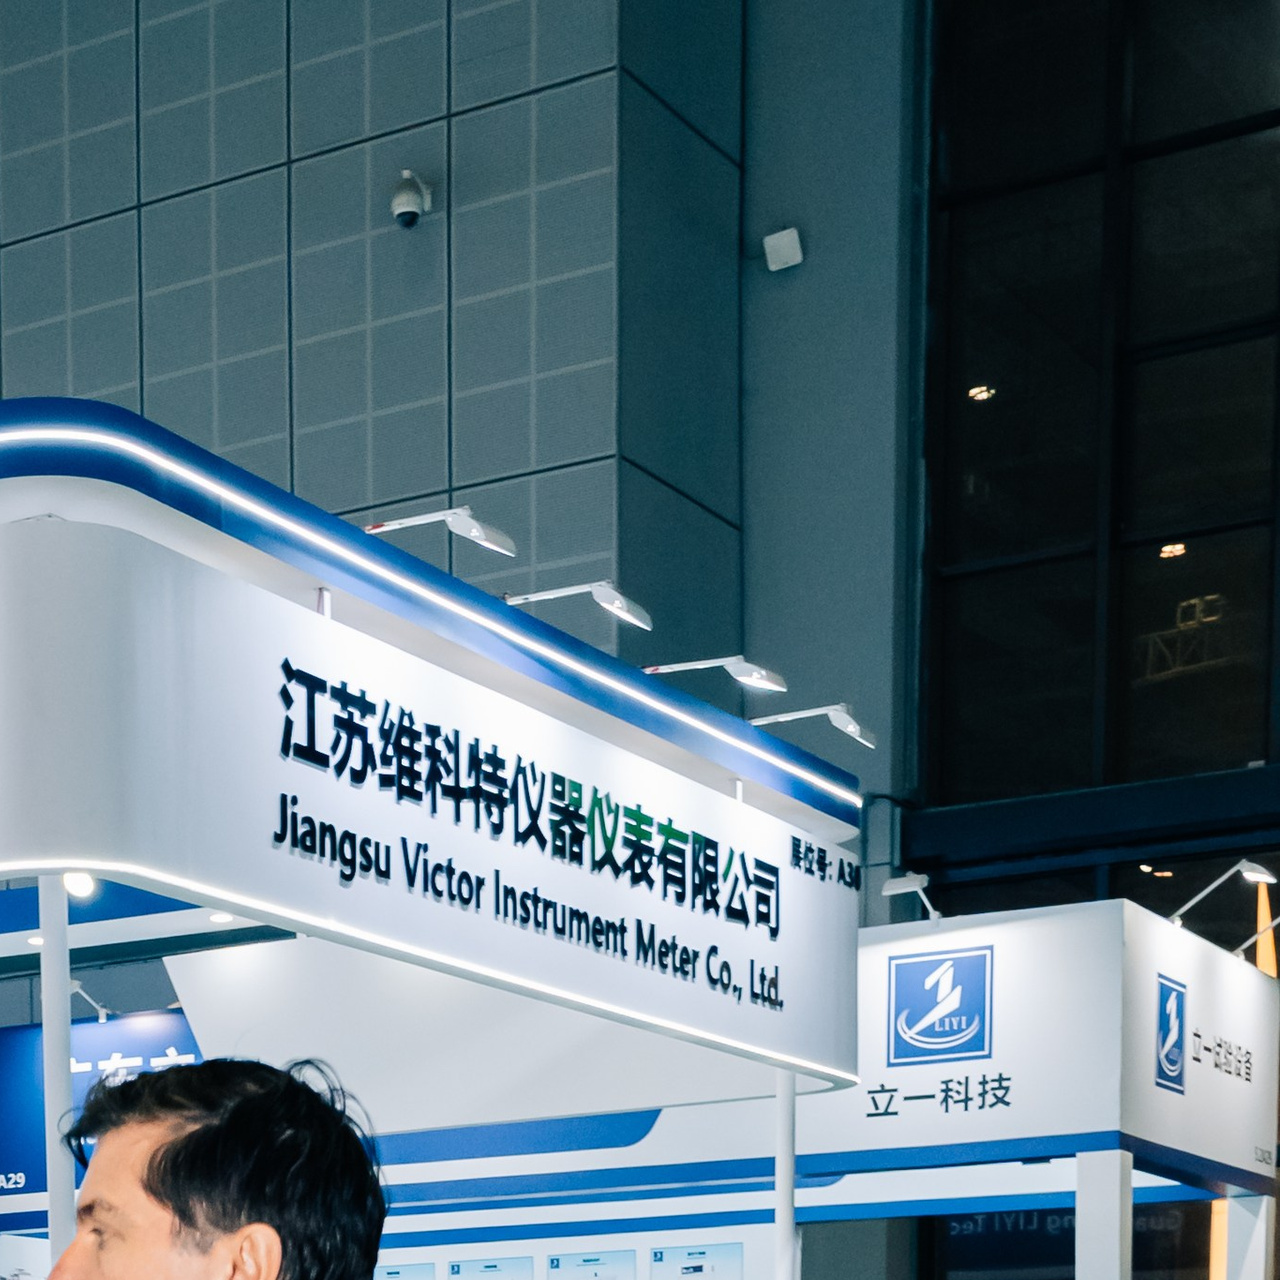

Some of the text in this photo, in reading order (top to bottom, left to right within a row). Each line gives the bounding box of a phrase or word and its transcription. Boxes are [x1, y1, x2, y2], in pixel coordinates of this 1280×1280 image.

[279, 657, 780, 938] 江苏维科特仪器仪表有限公司
[273, 793, 784, 1010] Jiangsu Victor Instrument Meter Co., Ltd.
[934, 1016, 968, 1032] LIYI
[866, 1072, 1012, 1118] 立一科技
